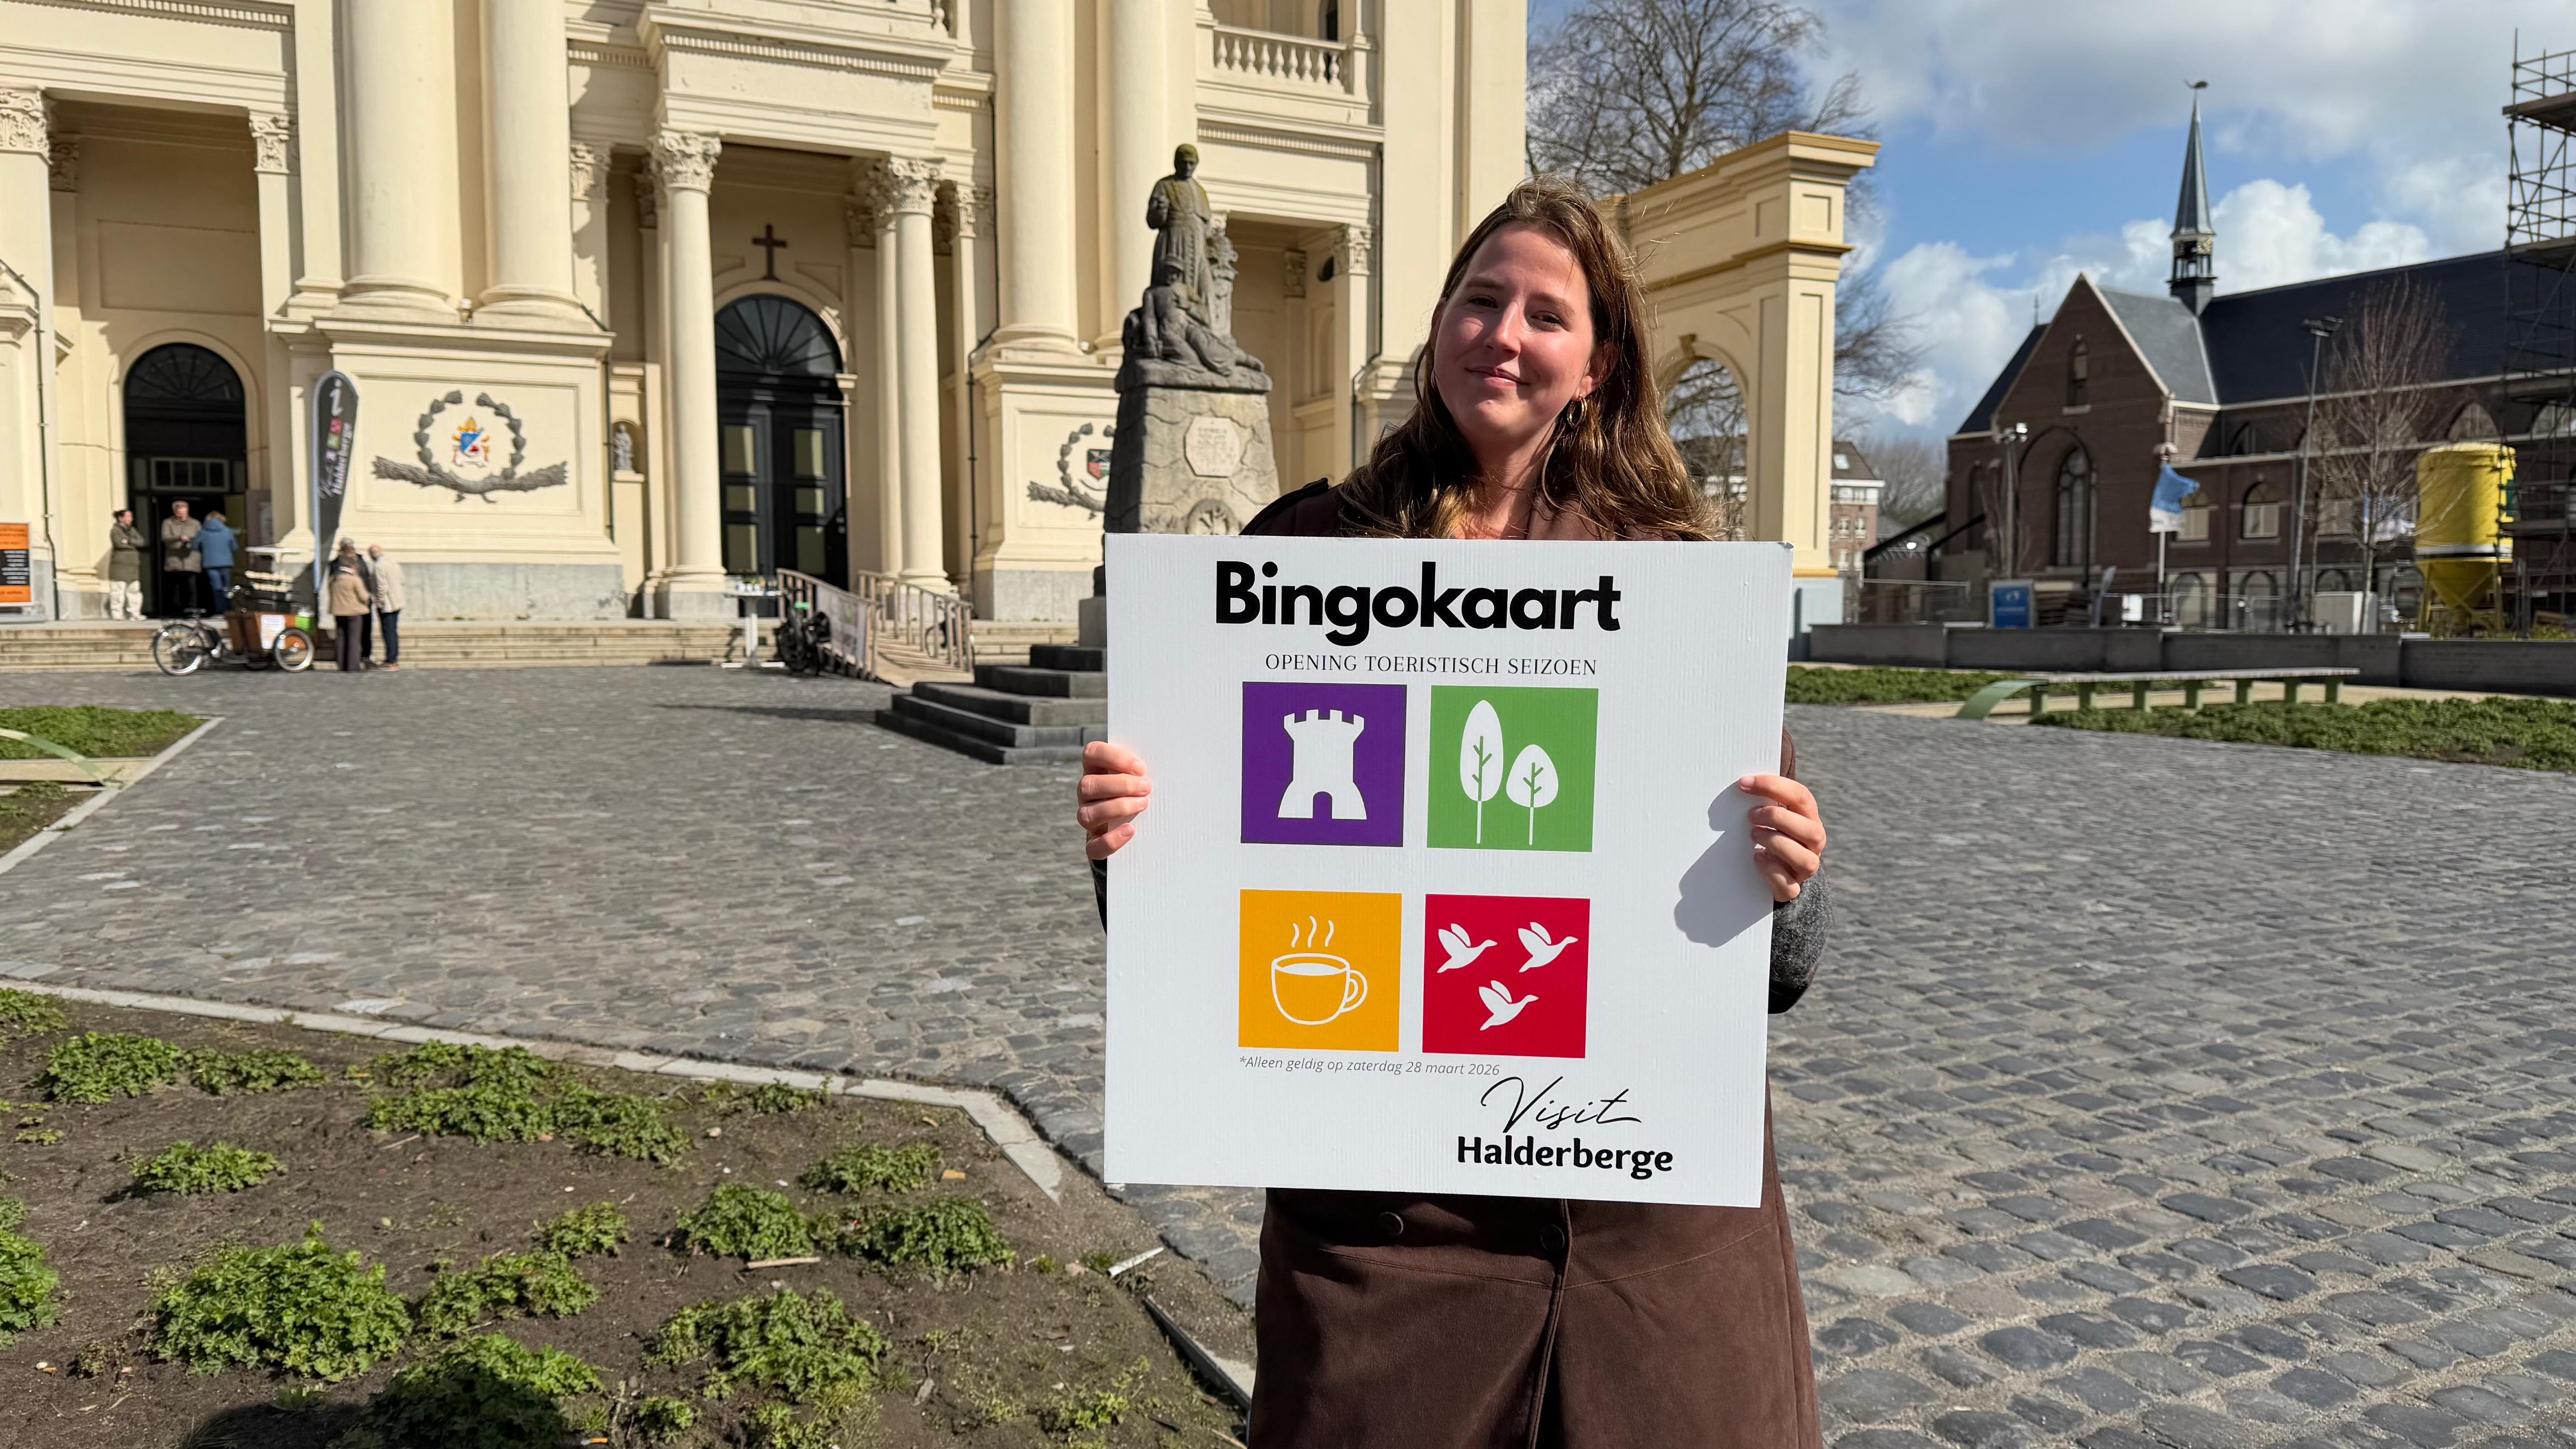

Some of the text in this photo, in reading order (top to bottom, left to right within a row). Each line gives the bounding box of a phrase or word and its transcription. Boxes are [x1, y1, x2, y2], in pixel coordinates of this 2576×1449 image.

[1215, 560, 1622, 647] Bingokaart
[1265, 653, 1597, 676] OPENING TOERISTISCH SEIZOEN
[1285, 1057, 1324, 1073] geldig
[1327, 1061, 1343, 1074] op
[1346, 1060, 1403, 1076] zaterdag
[1405, 1061, 1422, 1073] 28
[1425, 1064, 1465, 1075] maart
[1467, 1063, 1500, 1076] 2026
[1480, 1075, 1642, 1134] Visit
[1457, 1134, 1674, 1180] Halderberge
